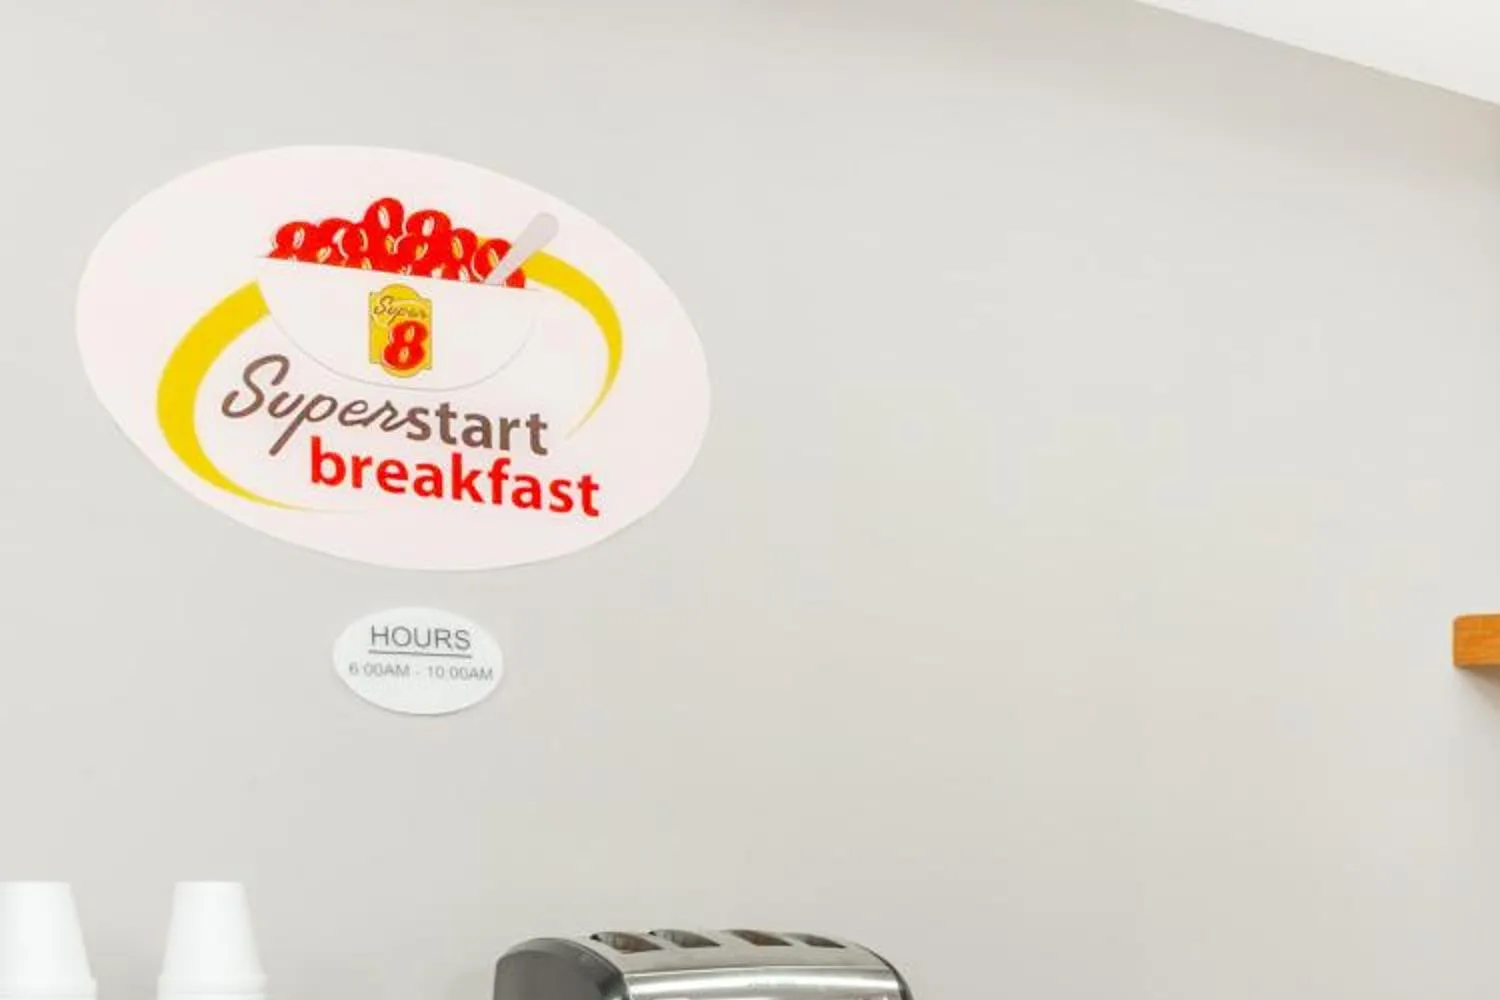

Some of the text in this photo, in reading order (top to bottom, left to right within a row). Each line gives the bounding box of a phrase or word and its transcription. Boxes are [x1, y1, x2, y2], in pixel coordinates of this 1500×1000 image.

[383, 320, 428, 371] 8
[221, 354, 549, 456] Superstart
[310, 436, 600, 517] breakfast
[371, 625, 471, 650] HOURS
[348, 662, 411, 678] 600AM
[427, 664, 494, 682] 1000AM
